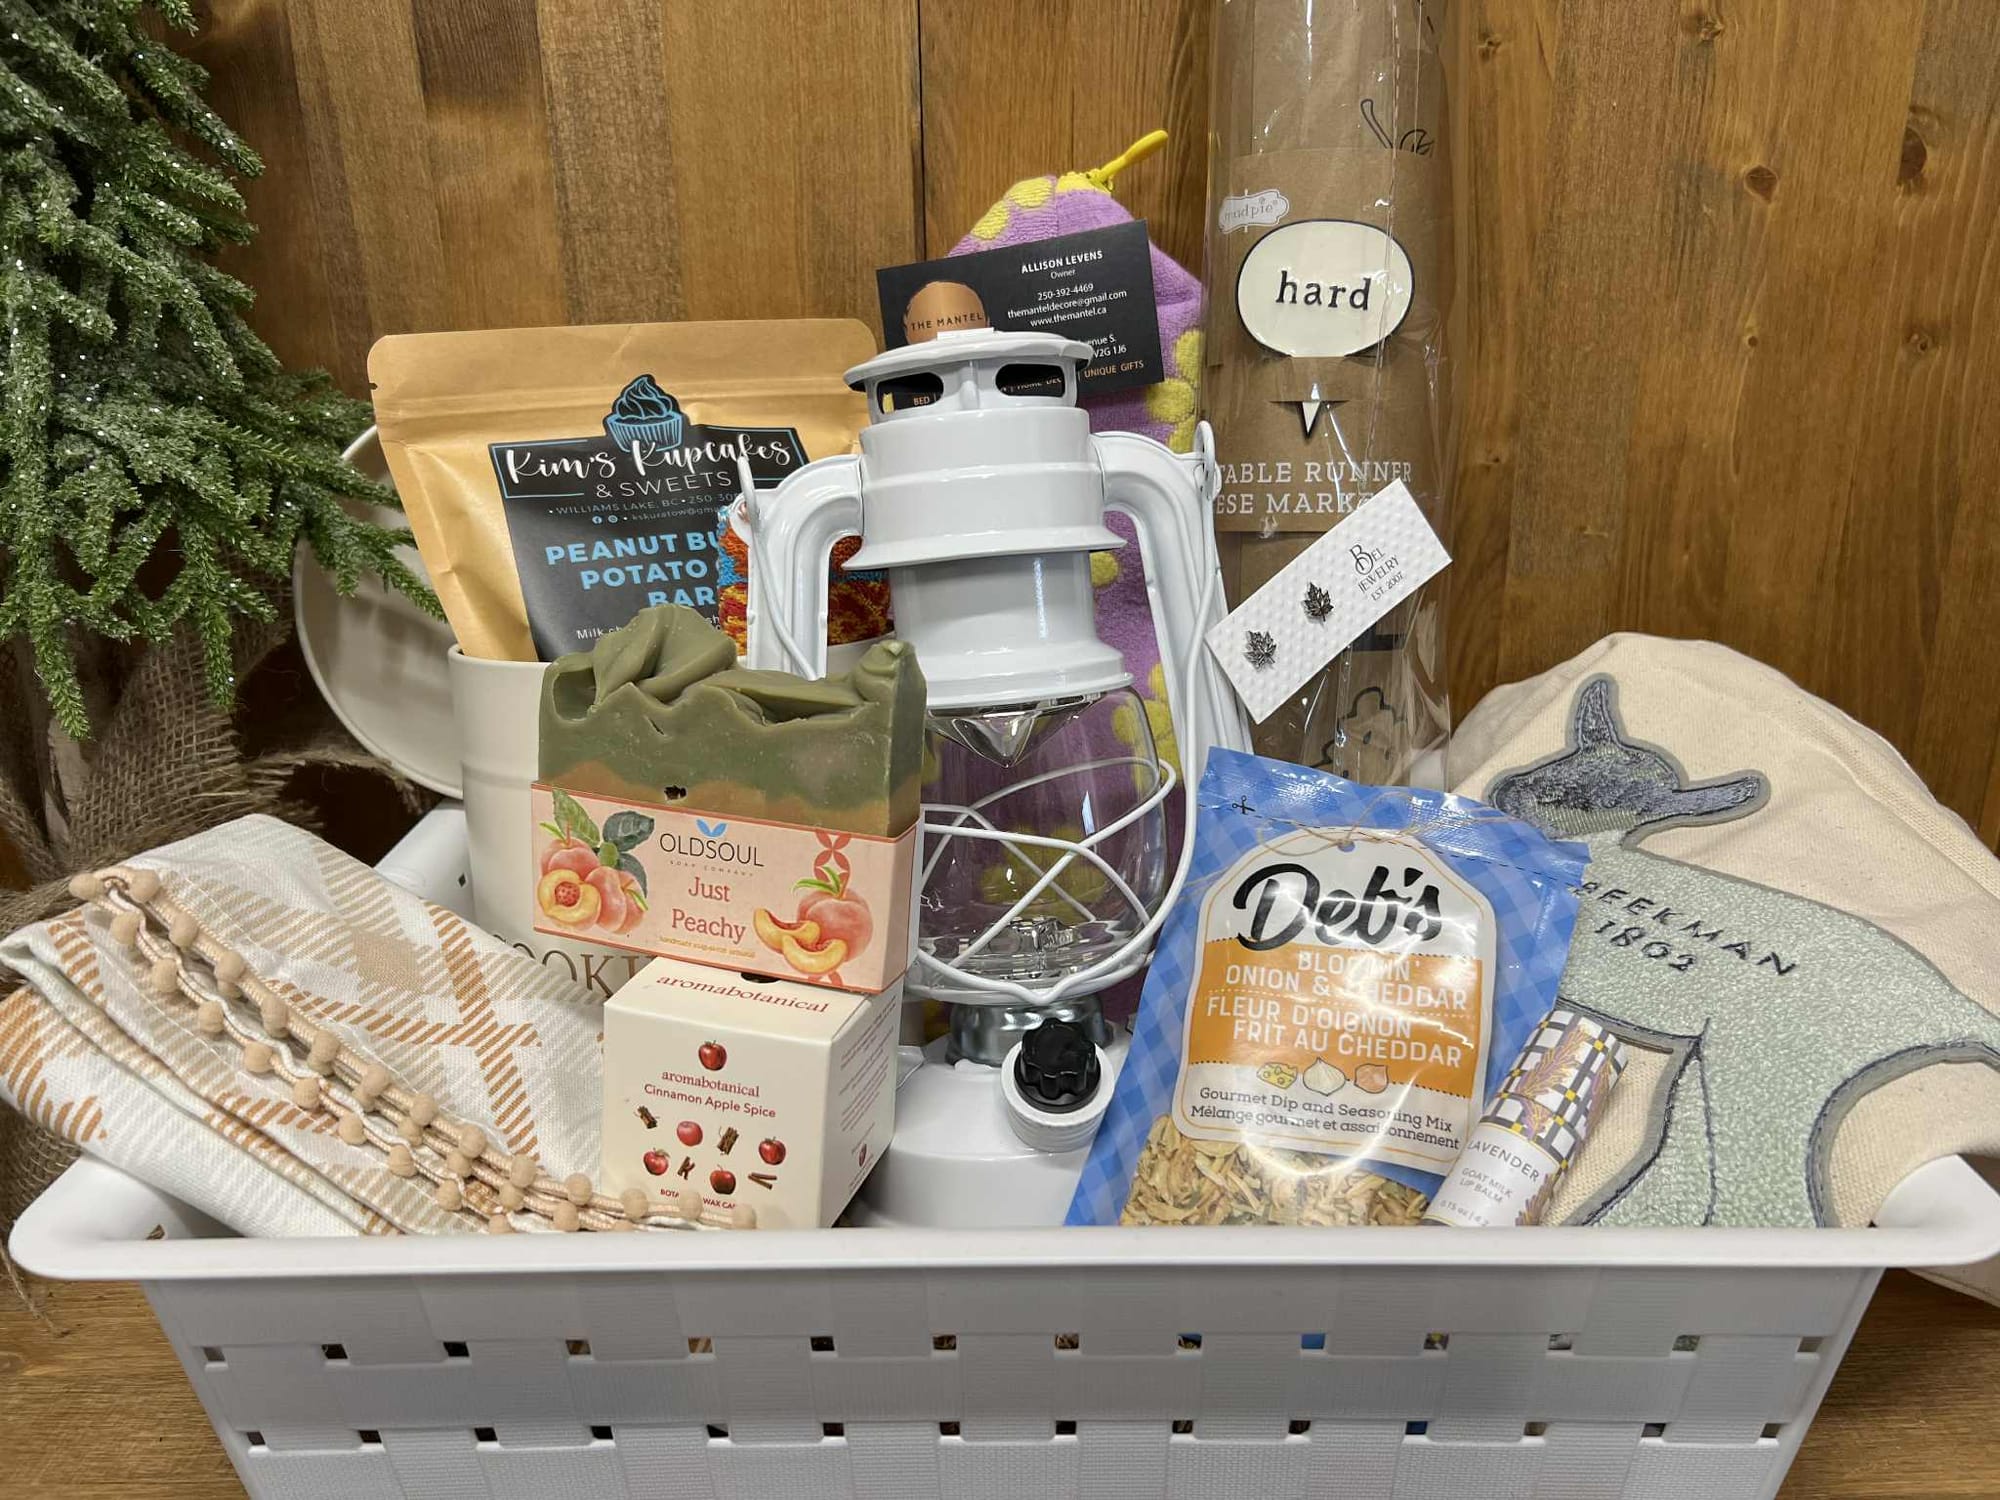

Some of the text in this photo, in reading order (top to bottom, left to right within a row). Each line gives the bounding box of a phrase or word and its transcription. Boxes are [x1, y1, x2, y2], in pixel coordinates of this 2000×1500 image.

[1021, 250, 1104, 274] ALLISON LEVENS
[1050, 269, 1076, 279] Owner
[1007, 290, 1127, 319] themanteldecore@gmail.com
[1037, 283, 1094, 301] 250-392-4469
[1275, 270, 1372, 311] hard
[910, 312, 984, 330] THE MANTEL
[1030, 307, 1107, 327] www.themantel.ca
[1084, 359, 1145, 378] UNIQUE GIFTS
[913, 396, 930, 406] BED
[505, 433, 791, 484] Kim's Kupcakes
[1304, 461, 1412, 483] RUNNER
[596, 471, 733, 498] & SWEETS
[556, 503, 620, 515] WILLIAMS
[661, 498, 679, 507] BC
[545, 532, 678, 565] PEANUT
[580, 559, 708, 590] POTATO
[1358, 556, 1399, 594] JEWELRY
[576, 625, 604, 640] Milk
[659, 833, 765, 867] OLDSOUL
[688, 876, 731, 902] Just
[1233, 862, 1444, 951] Deb's
[672, 908, 746, 945] Peachy
[656, 974, 830, 1013] aromabotanical
[1226, 964, 1467, 1011] ONION & HEDDAR
[1207, 995, 1412, 1039] FLEUR D'OIGNON
[1233, 1020, 1462, 1068] FRIT AU CHEDDAR
[661, 1070, 760, 1097] aromabotanical
[644, 1083, 777, 1120] Cinnamon Apple Spice
[1200, 1087, 1268, 1105] Gourmet
[1270, 1094, 1298, 1113] Dip
[1303, 1100, 1334, 1114] and
[1426, 1117, 1453, 1133] Mix
[1191, 1104, 1253, 1124] Mélange
[1322, 1118, 1337, 1131] et
[1340, 1120, 1460, 1150] assaionnement
[1468, 1140, 1540, 1182] LAVENDER
[1462, 1167, 1513, 1198] GOAT MILK
[1474, 1184, 1503, 1203] BALM
[703, 1198, 721, 1208] WAX
